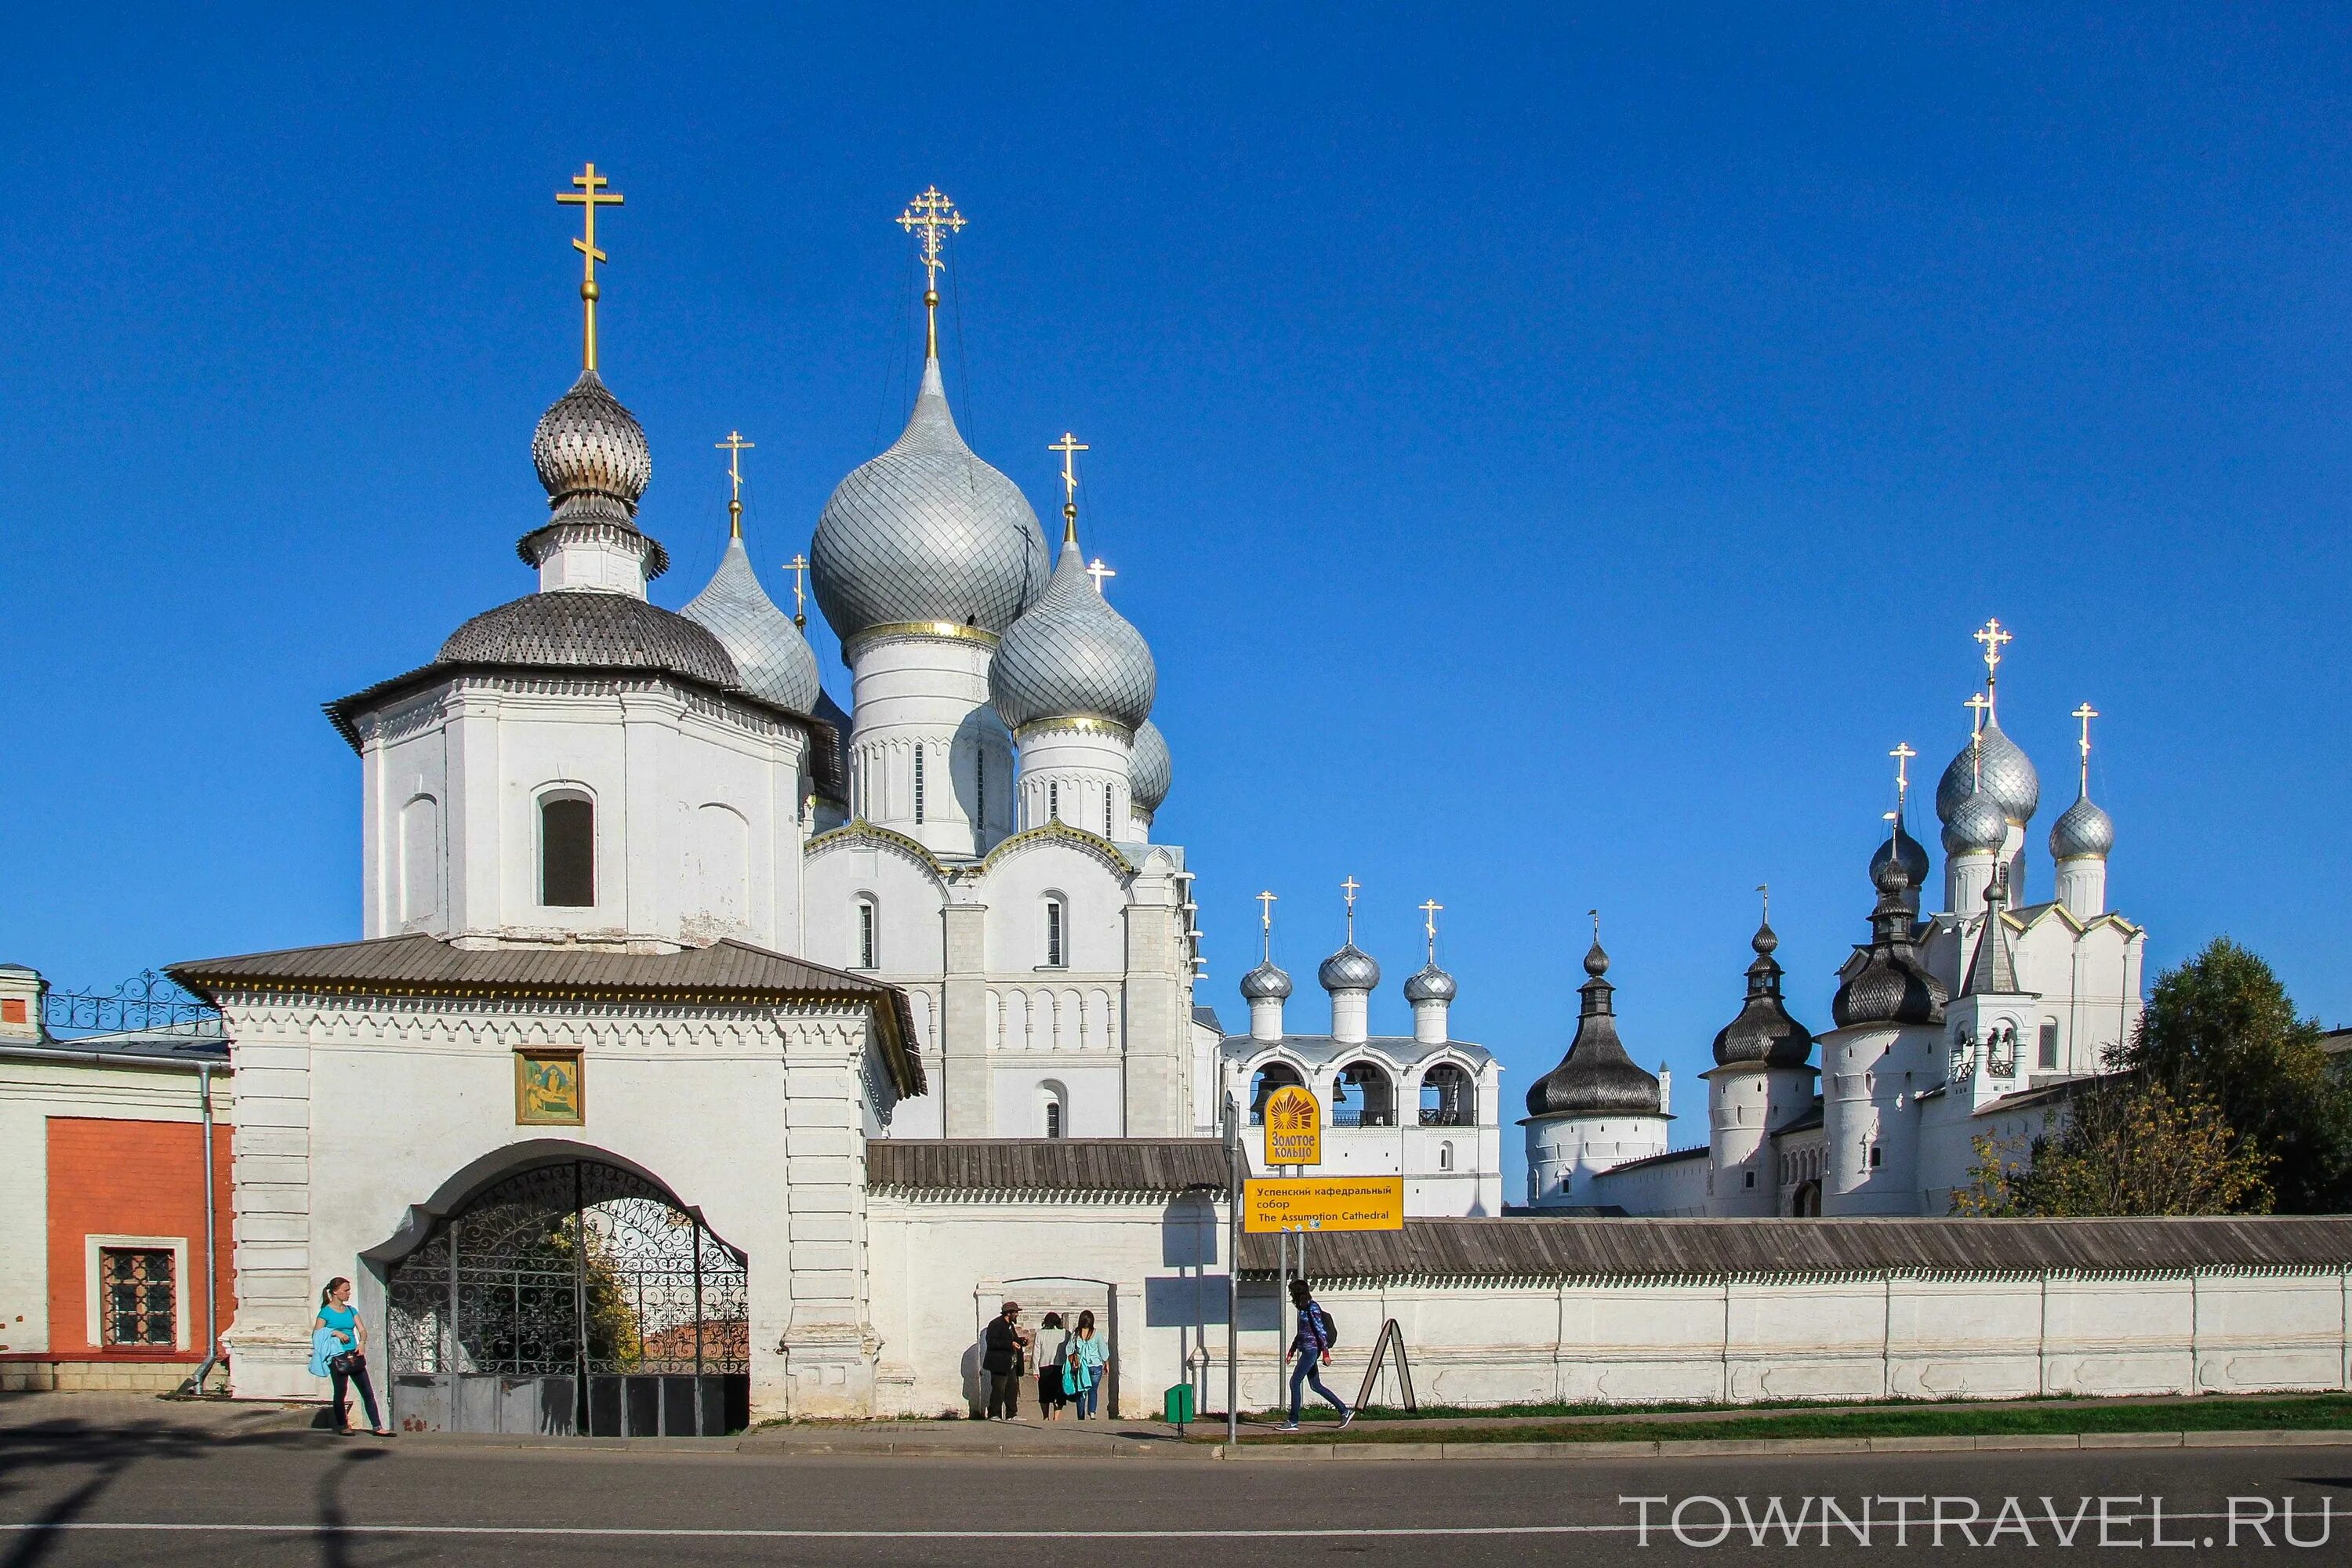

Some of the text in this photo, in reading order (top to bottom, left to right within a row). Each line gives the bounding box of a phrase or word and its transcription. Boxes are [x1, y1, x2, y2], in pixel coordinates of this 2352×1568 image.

[1257, 1185, 1392, 1197] Успенский кафедральный
[1257, 1200, 1290, 1210] собор
[1259, 1210, 1389, 1222] The Assumption Cathedral
